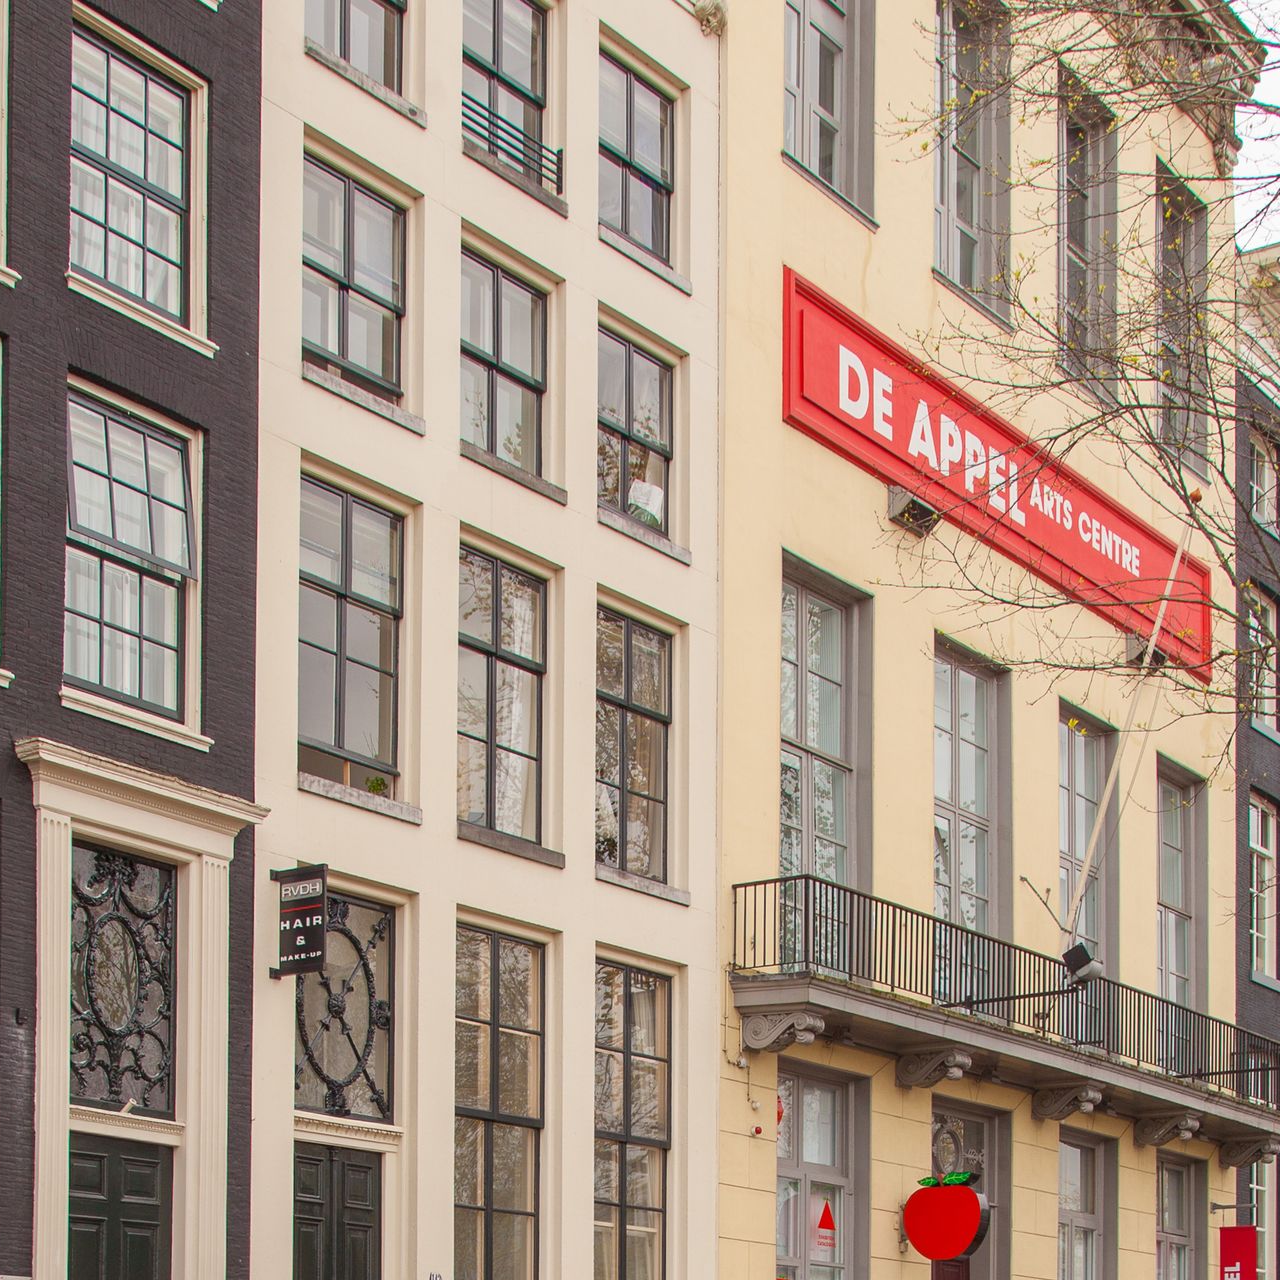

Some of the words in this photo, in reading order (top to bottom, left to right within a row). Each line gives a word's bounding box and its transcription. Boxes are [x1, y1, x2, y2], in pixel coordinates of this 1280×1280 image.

[838, 343, 893, 442] DE
[907, 398, 1026, 528] APPEL
[1029, 477, 1073, 531] ARTS
[1078, 511, 1140, 578] CENTRE
[281, 882, 321, 898] RVDH
[280, 915, 323, 931] HAIR
[295, 935, 306, 946] &
[280, 950, 322, 962] MAKE-UP
